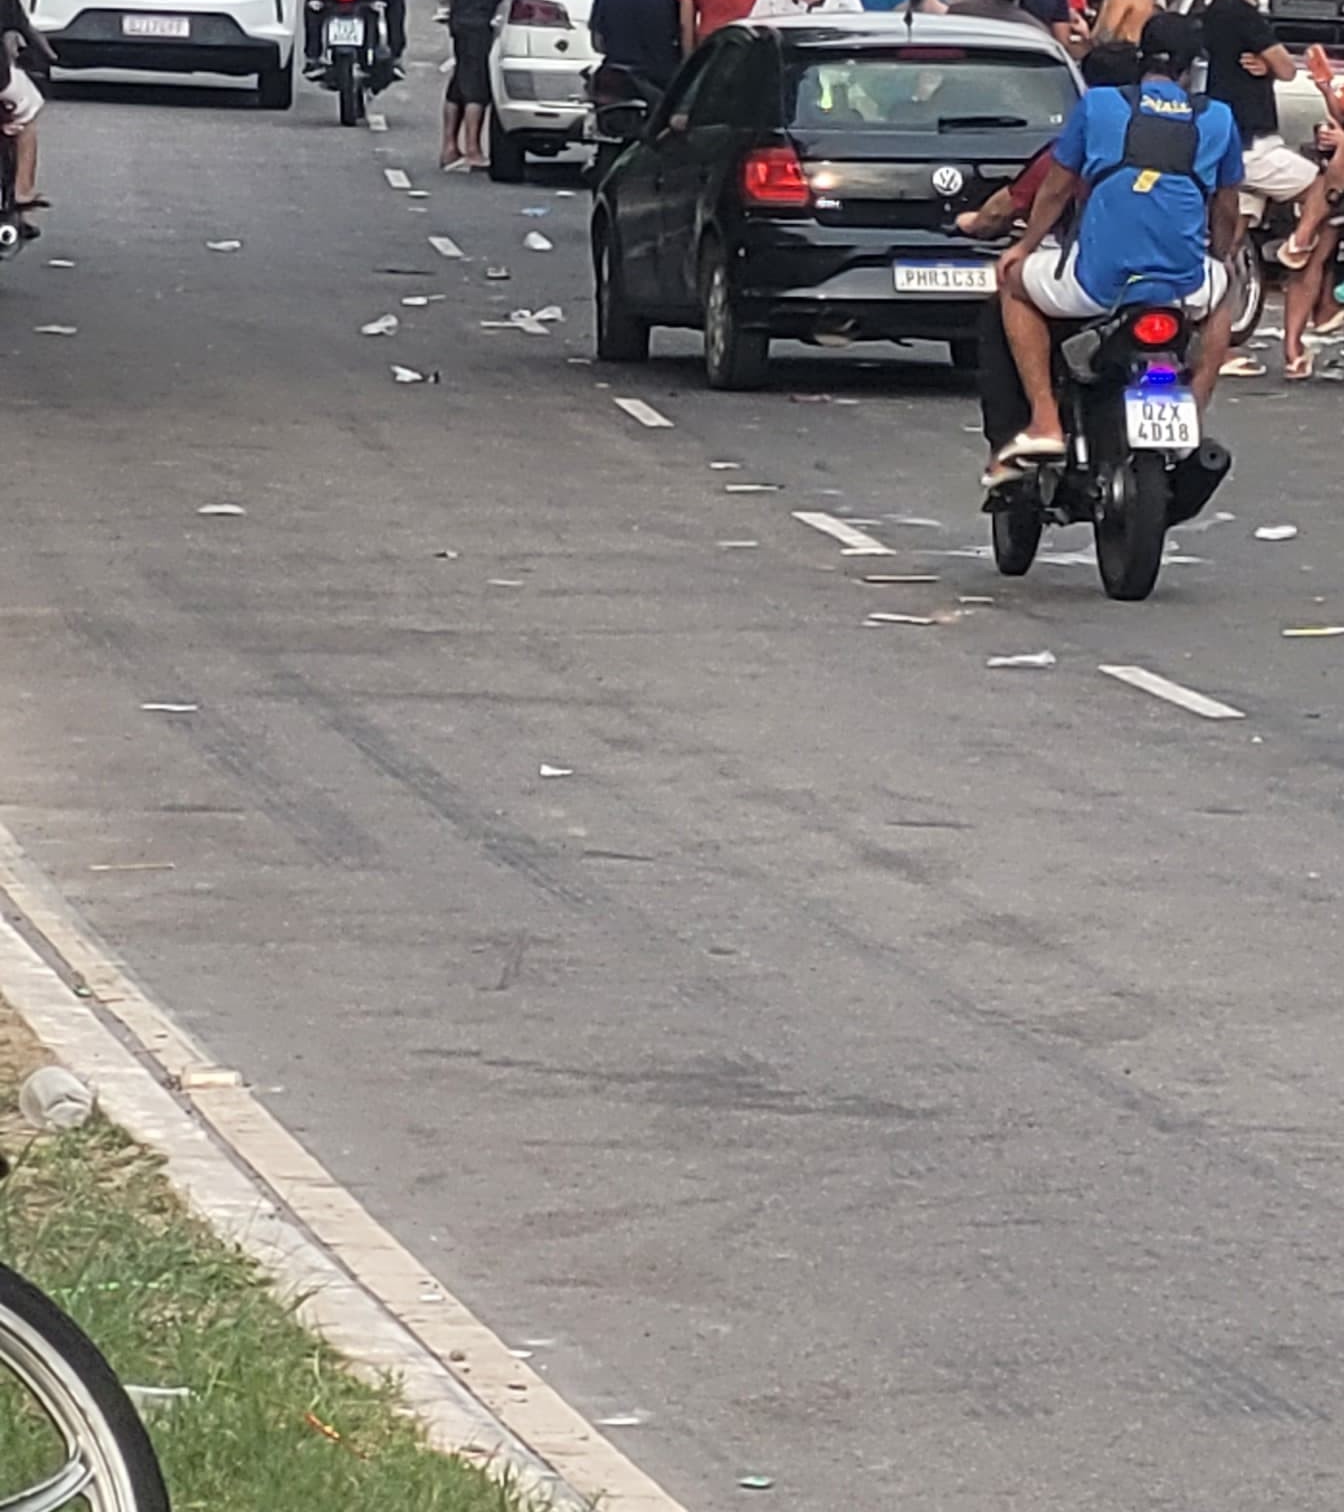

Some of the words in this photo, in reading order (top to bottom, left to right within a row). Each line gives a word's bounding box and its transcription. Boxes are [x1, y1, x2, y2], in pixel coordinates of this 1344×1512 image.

[904, 270, 987, 288] PHR1C33
[1142, 402, 1181, 422] QZX
[1137, 422, 1189, 442] 4D18
